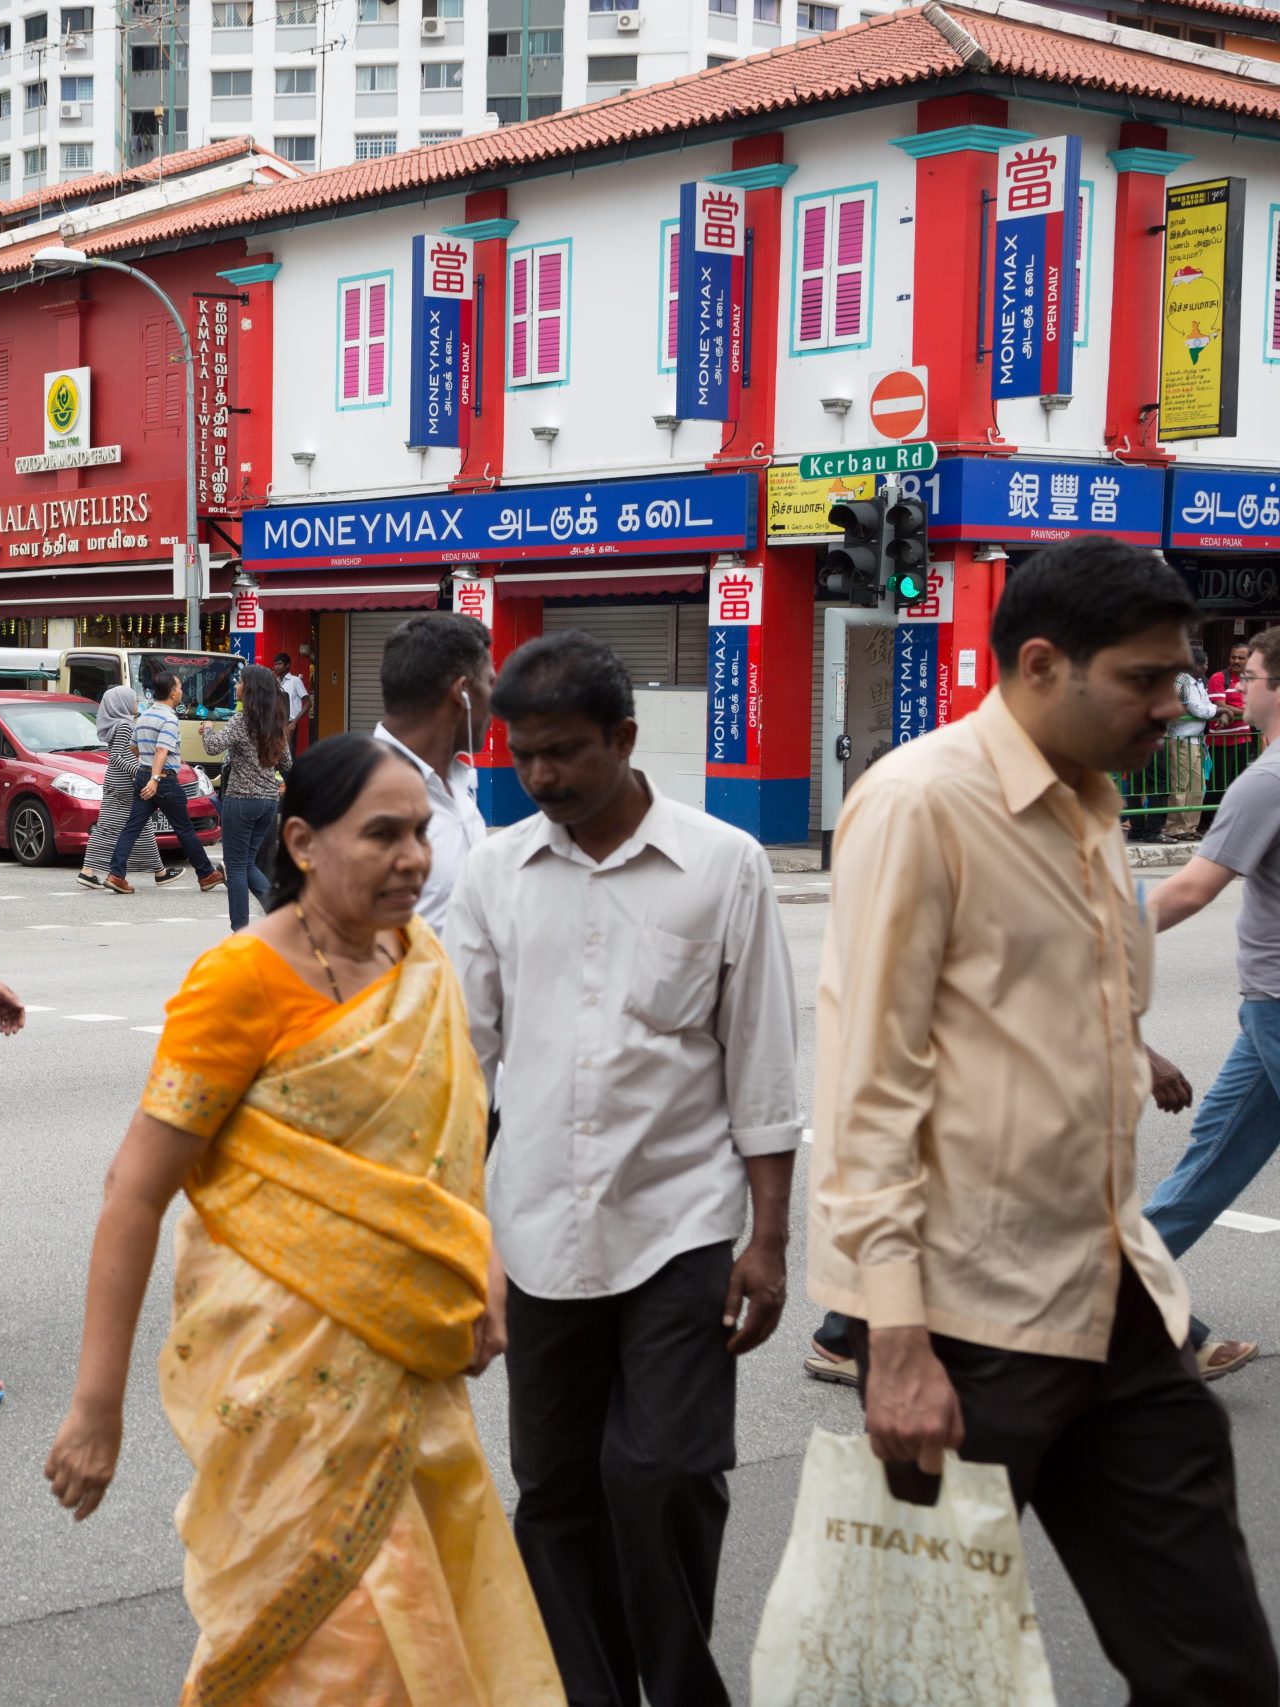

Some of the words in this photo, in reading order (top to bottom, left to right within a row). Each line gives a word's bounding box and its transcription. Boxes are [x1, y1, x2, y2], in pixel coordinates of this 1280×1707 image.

[1006, 146, 1057, 212] 當
[1171, 192, 1204, 203] WESTERN
[702, 191, 739, 248] 當
[431, 242, 468, 293] 當
[1024, 254, 1035, 298] கடை
[1048, 265, 1059, 302] DAILY
[215, 302, 227, 346] கமலா
[716, 289, 724, 329] கடை
[733, 303, 741, 338] DAILY
[999, 234, 1018, 385] MONEYMAX
[1045, 301, 1057, 342] OPEN
[198, 300, 210, 379] KAMALA
[445, 330, 453, 366] கடை
[698, 266, 712, 405] MONEYMAX
[1020, 304, 1034, 360] அடகுக்
[428, 310, 441, 435] MONEYMAX
[461, 342, 470, 373] DAILY
[714, 335, 724, 386] அடகுக்
[731, 341, 740, 374] OPEN
[443, 371, 453, 416] அடகுக்
[461, 376, 469, 405] OPEN
[198, 386, 210, 503] JEWELLERS
[810, 453, 886, 477] Kerbau
[897, 447, 923, 468] Rd
[41, 493, 148, 536] JEWELLERS
[208, 506, 227, 514] NO:81
[488, 492, 598, 541] அடகுக்
[617, 498, 713, 532] கடை
[1008, 471, 1120, 523] 銀豐當
[160, 536, 179, 545] NO:81
[264, 508, 464, 549] MONEYMAX
[1030, 529, 1070, 541] PAWNSHOP
[1200, 537, 1220, 547] KEDAI
[1222, 538, 1243, 547] PAJAK
[330, 557, 362, 567] PAWNSHOP
[441, 552, 460, 561] KEDAI
[461, 551, 480, 560] PAJAK
[598, 544, 619, 554] கடை
[235, 591, 260, 628] 當
[718, 574, 753, 621] 當
[731, 650, 740, 687] கடை
[749, 662, 758, 695] DAILY
[899, 629, 914, 746] ONEYMAX
[919, 650, 928, 689] கடை
[939, 663, 949, 698] DAILY
[714, 631, 726, 759] MONEYMAX
[748, 696, 757, 728] OPEN
[729, 694, 739, 740] அடகுக்
